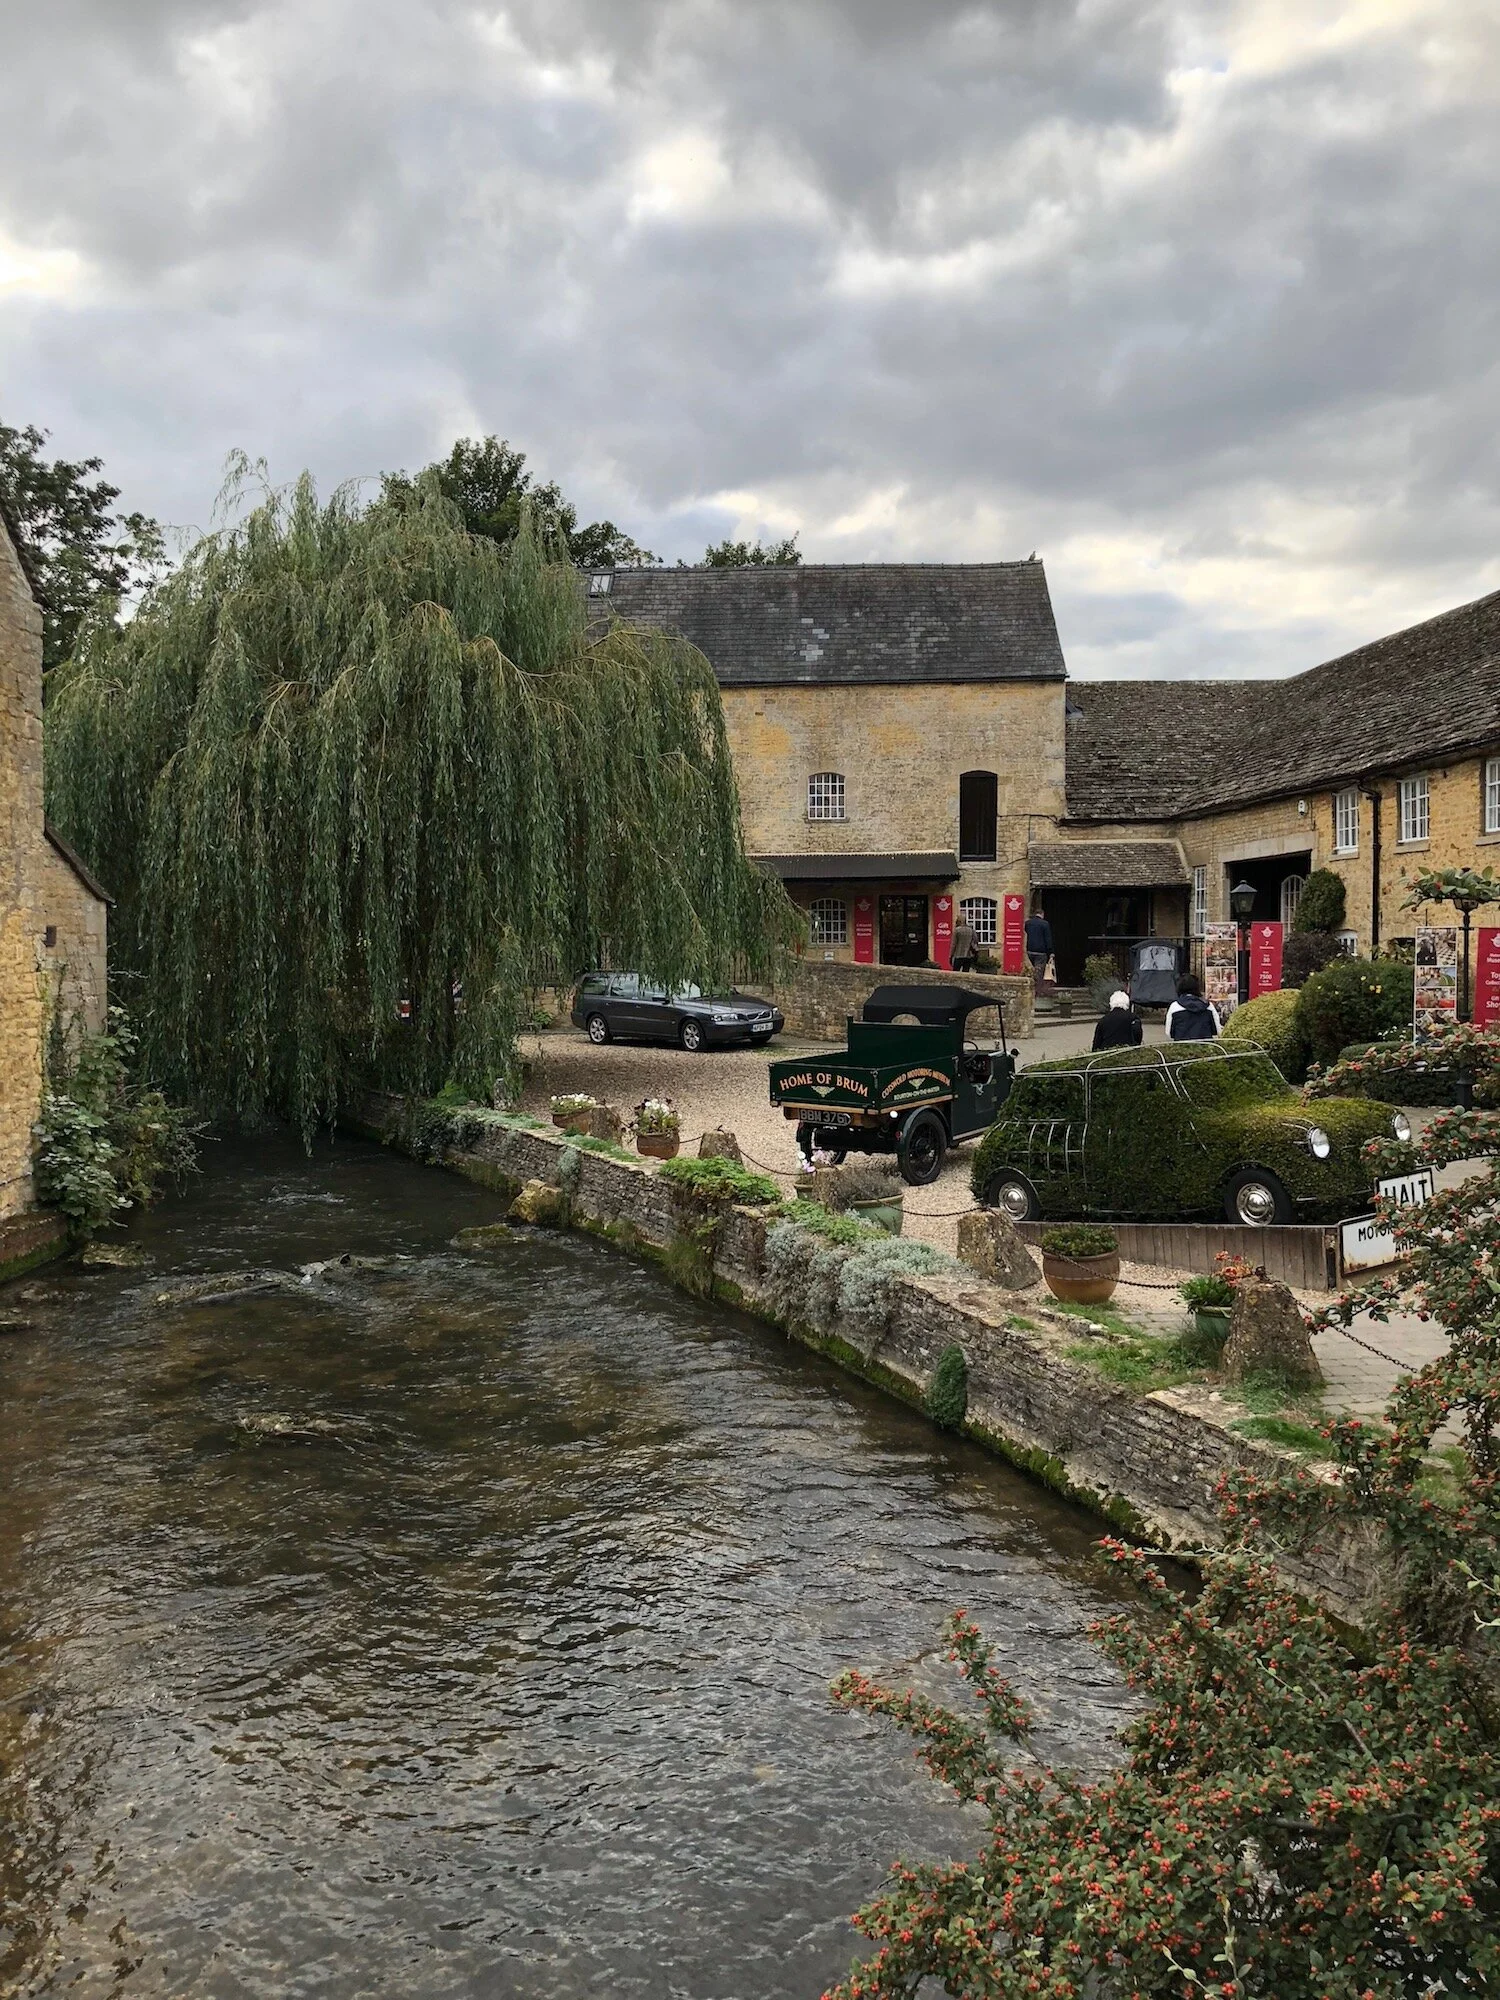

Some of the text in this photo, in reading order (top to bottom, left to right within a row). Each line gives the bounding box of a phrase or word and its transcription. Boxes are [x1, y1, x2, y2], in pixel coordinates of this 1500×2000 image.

[780, 1072, 868, 1097] HOME OF BRUM
[823, 1111, 845, 1124] 376
